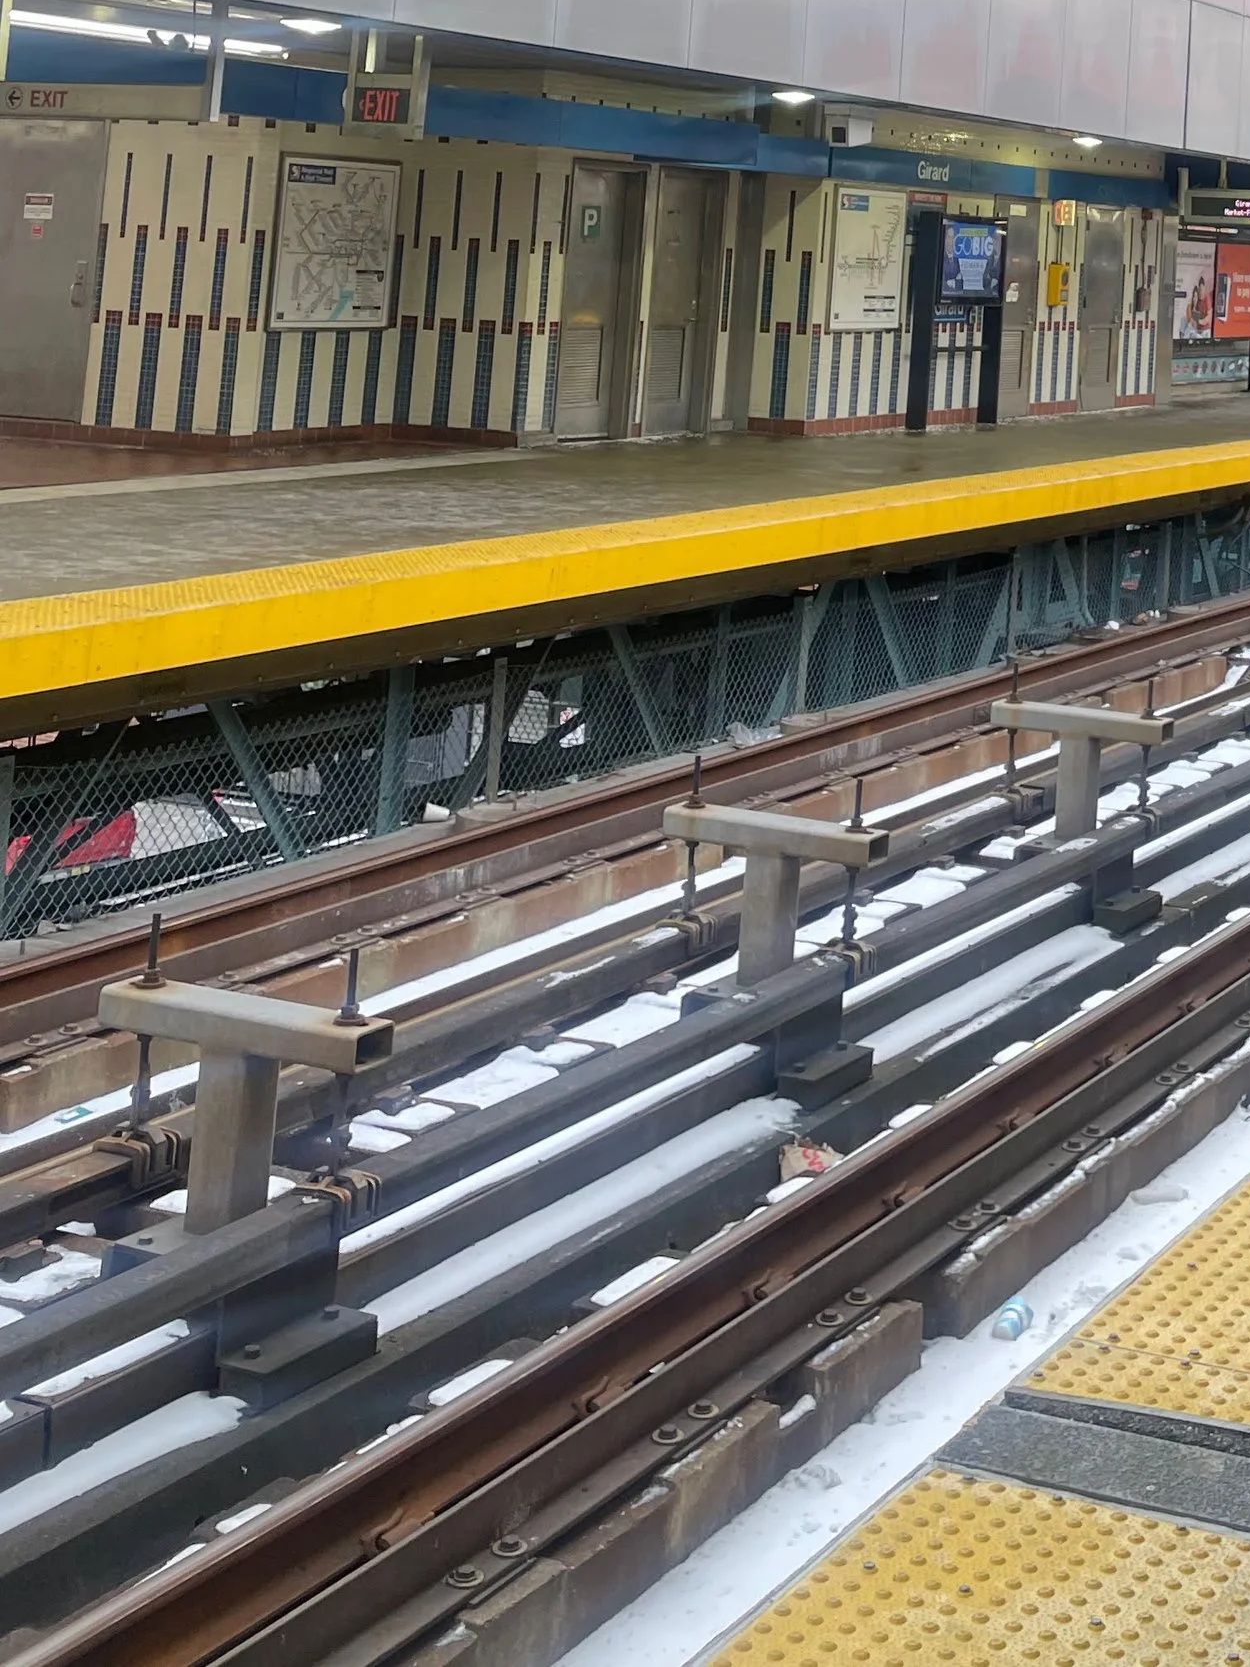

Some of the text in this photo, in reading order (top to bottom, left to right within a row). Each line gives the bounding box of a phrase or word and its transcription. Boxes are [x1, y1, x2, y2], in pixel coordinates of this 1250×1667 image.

[30, 90, 68, 108] EXIT
[363, 90, 400, 122] EXIT
[917, 160, 950, 182] Girard
[583, 208, 598, 236] P
